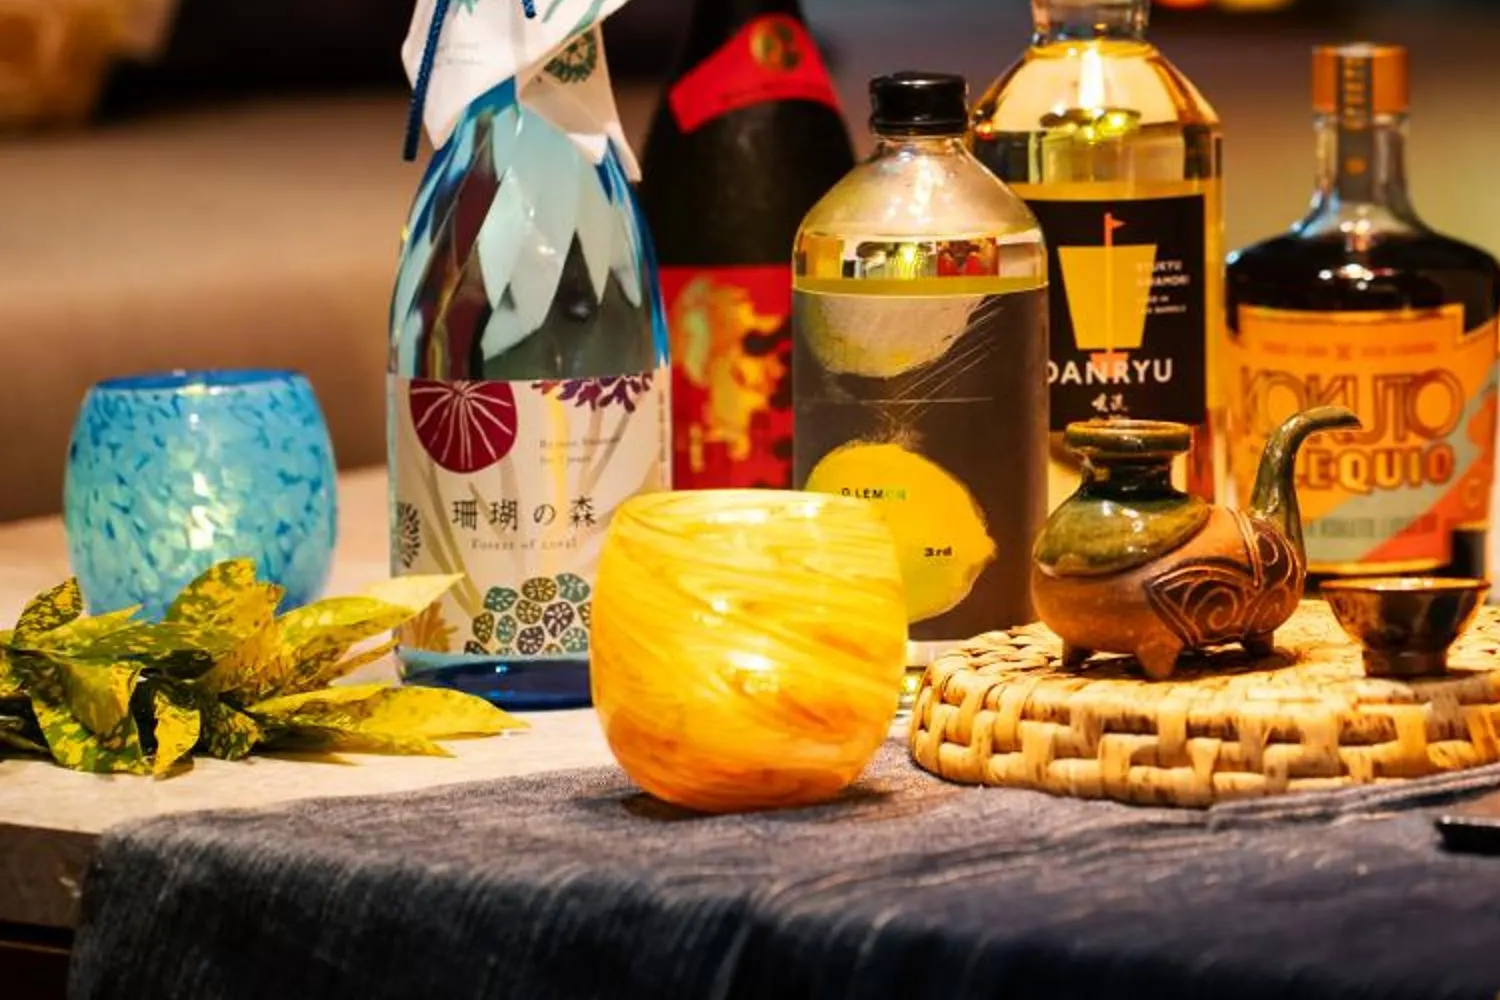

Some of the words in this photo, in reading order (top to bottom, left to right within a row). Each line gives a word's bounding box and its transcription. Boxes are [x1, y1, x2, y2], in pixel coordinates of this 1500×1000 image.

[1296, 442, 1456, 496] EQUIO
[452, 495, 597, 531] 珊瑚の森
[924, 545, 953, 558] 3rd
